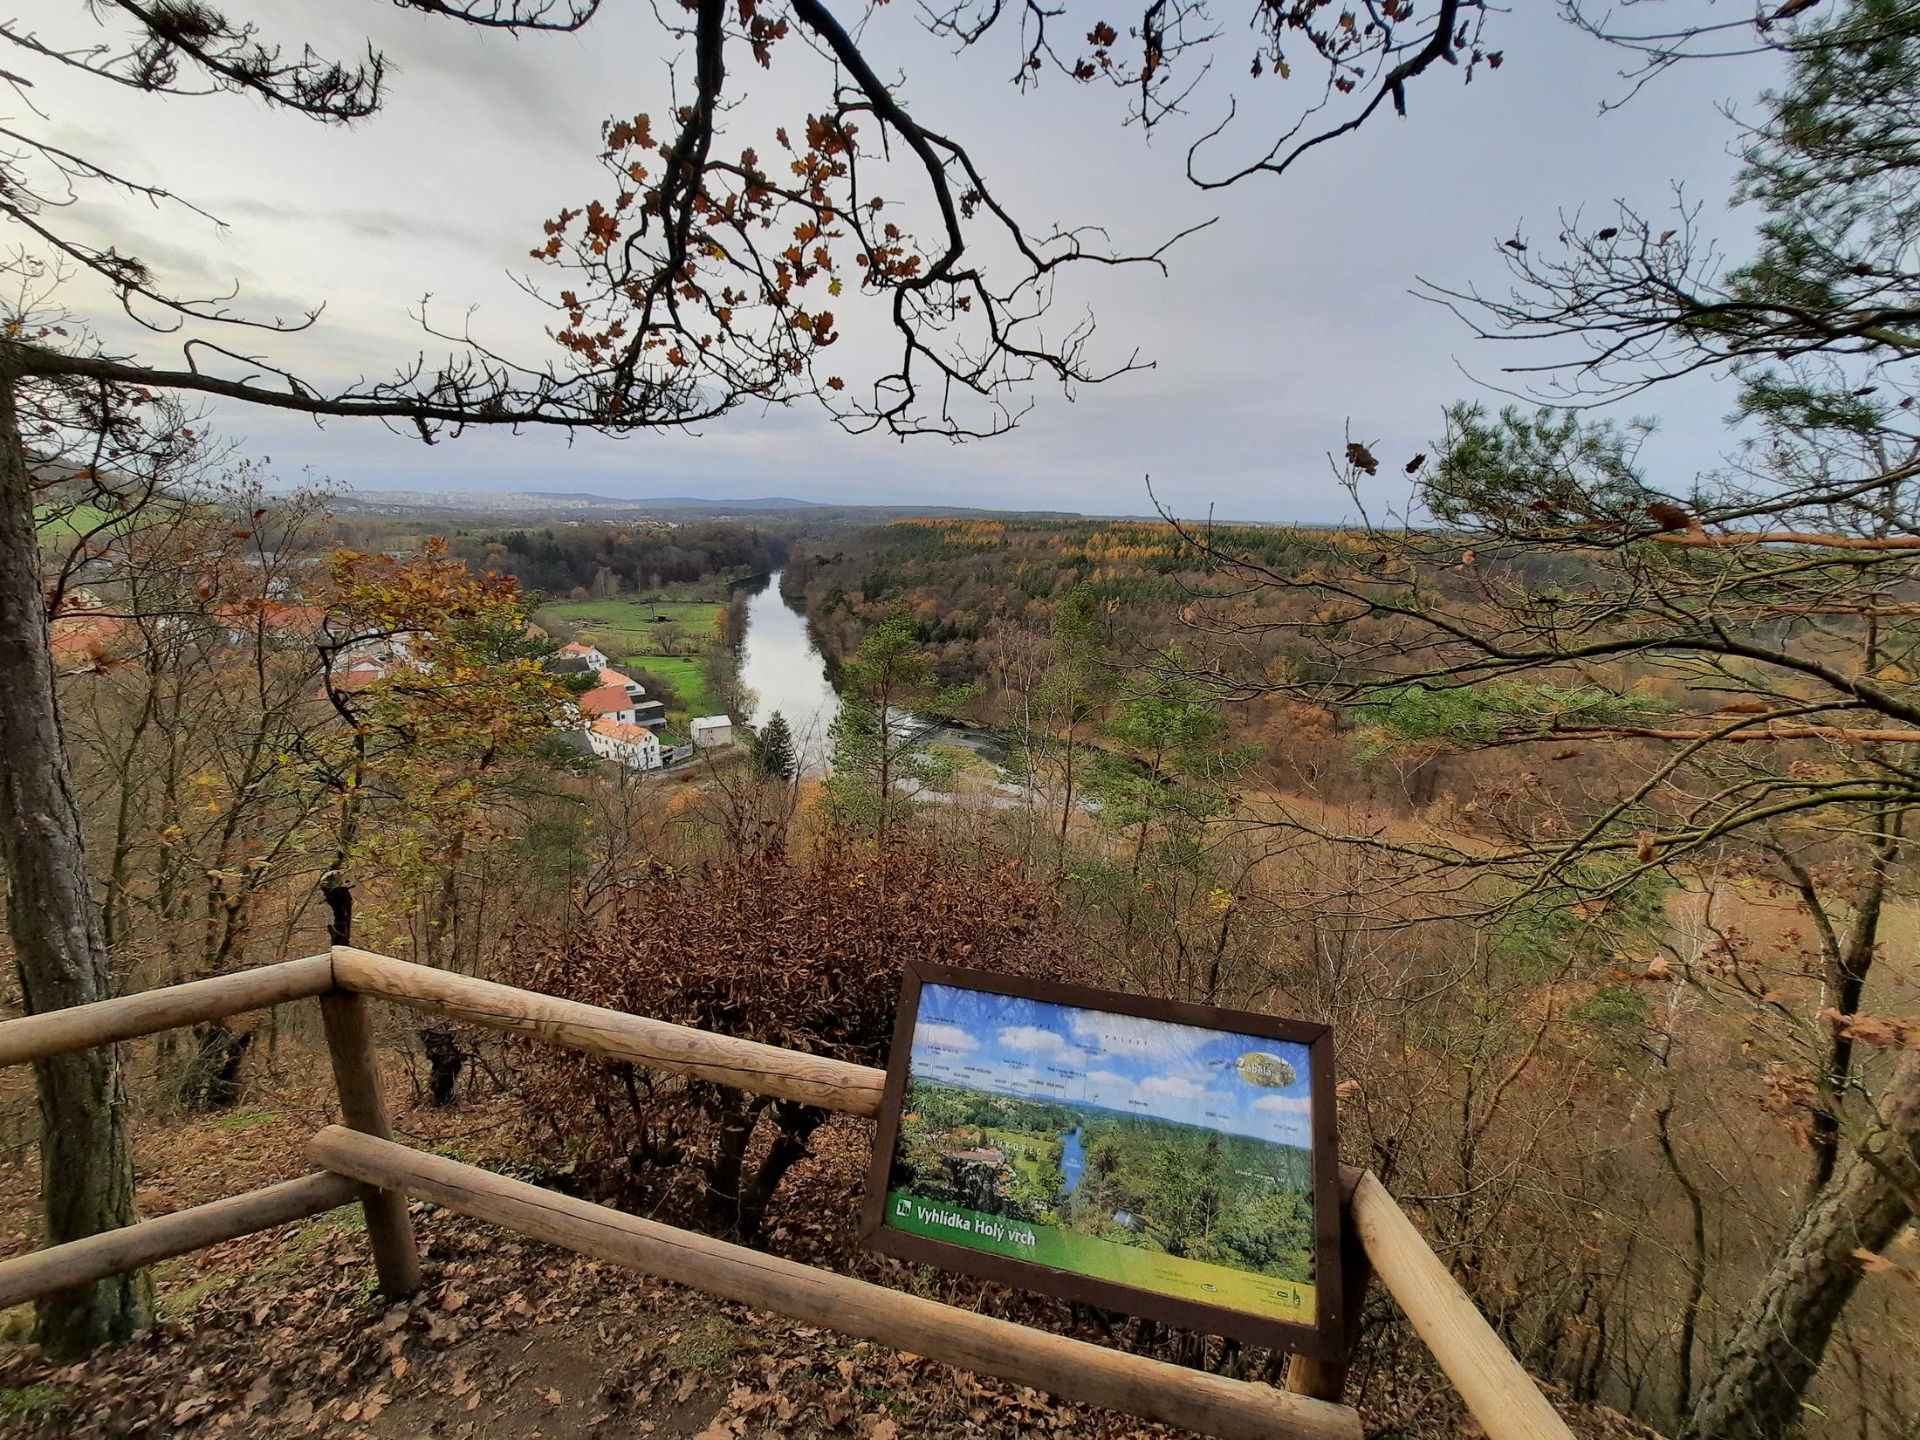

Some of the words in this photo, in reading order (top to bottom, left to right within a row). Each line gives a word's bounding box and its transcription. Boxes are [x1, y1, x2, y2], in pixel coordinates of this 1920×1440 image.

[917, 1205, 971, 1231] Vyhlídka
[974, 1219, 1005, 1242] Holý
[1008, 1229, 1036, 1246] vrch
